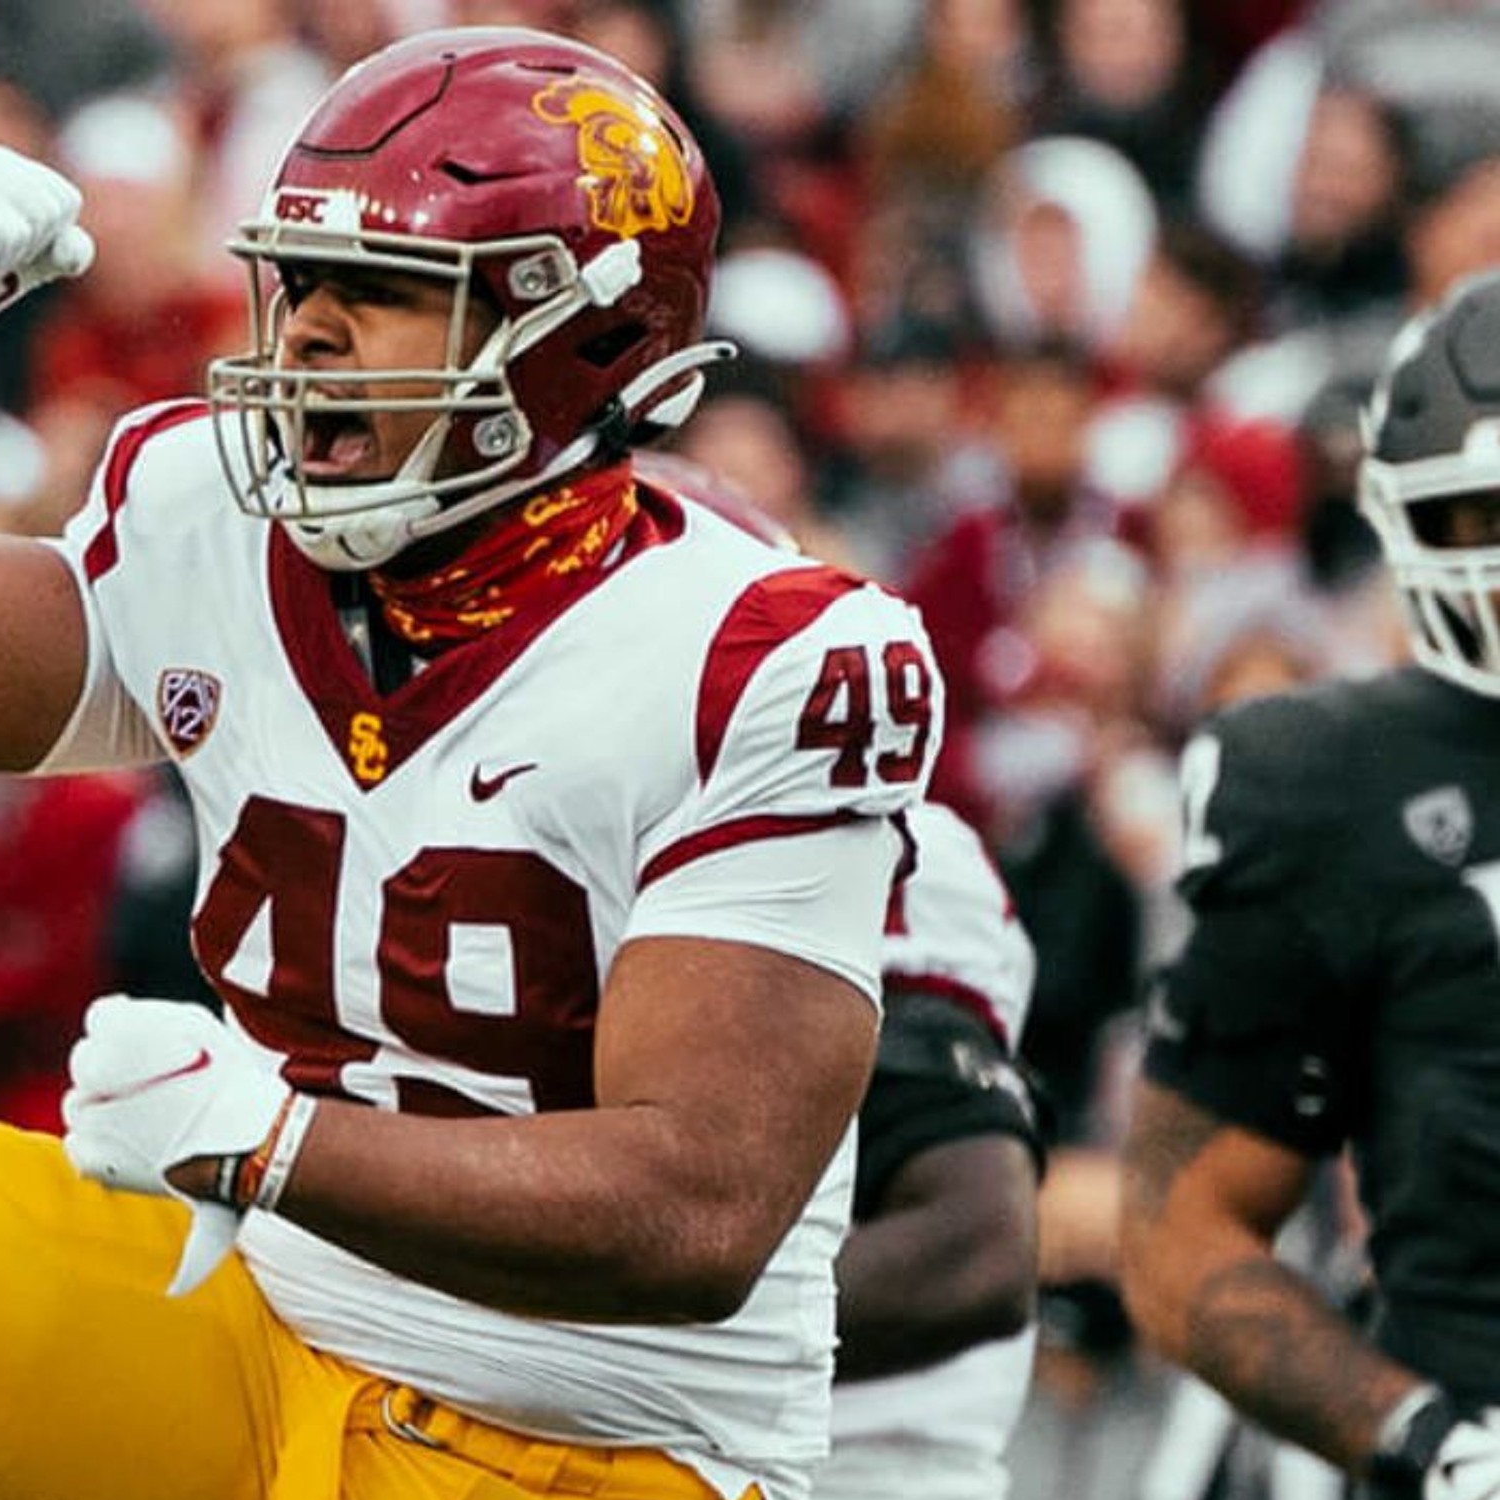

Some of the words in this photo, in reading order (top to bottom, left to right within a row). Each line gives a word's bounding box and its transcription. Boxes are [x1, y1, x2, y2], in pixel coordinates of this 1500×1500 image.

[276, 194, 329, 223] USC
[170, 705, 201, 739] 12
[349, 711, 388, 780] SC
[795, 640, 932, 788] 49
[190, 793, 600, 1118] 49
